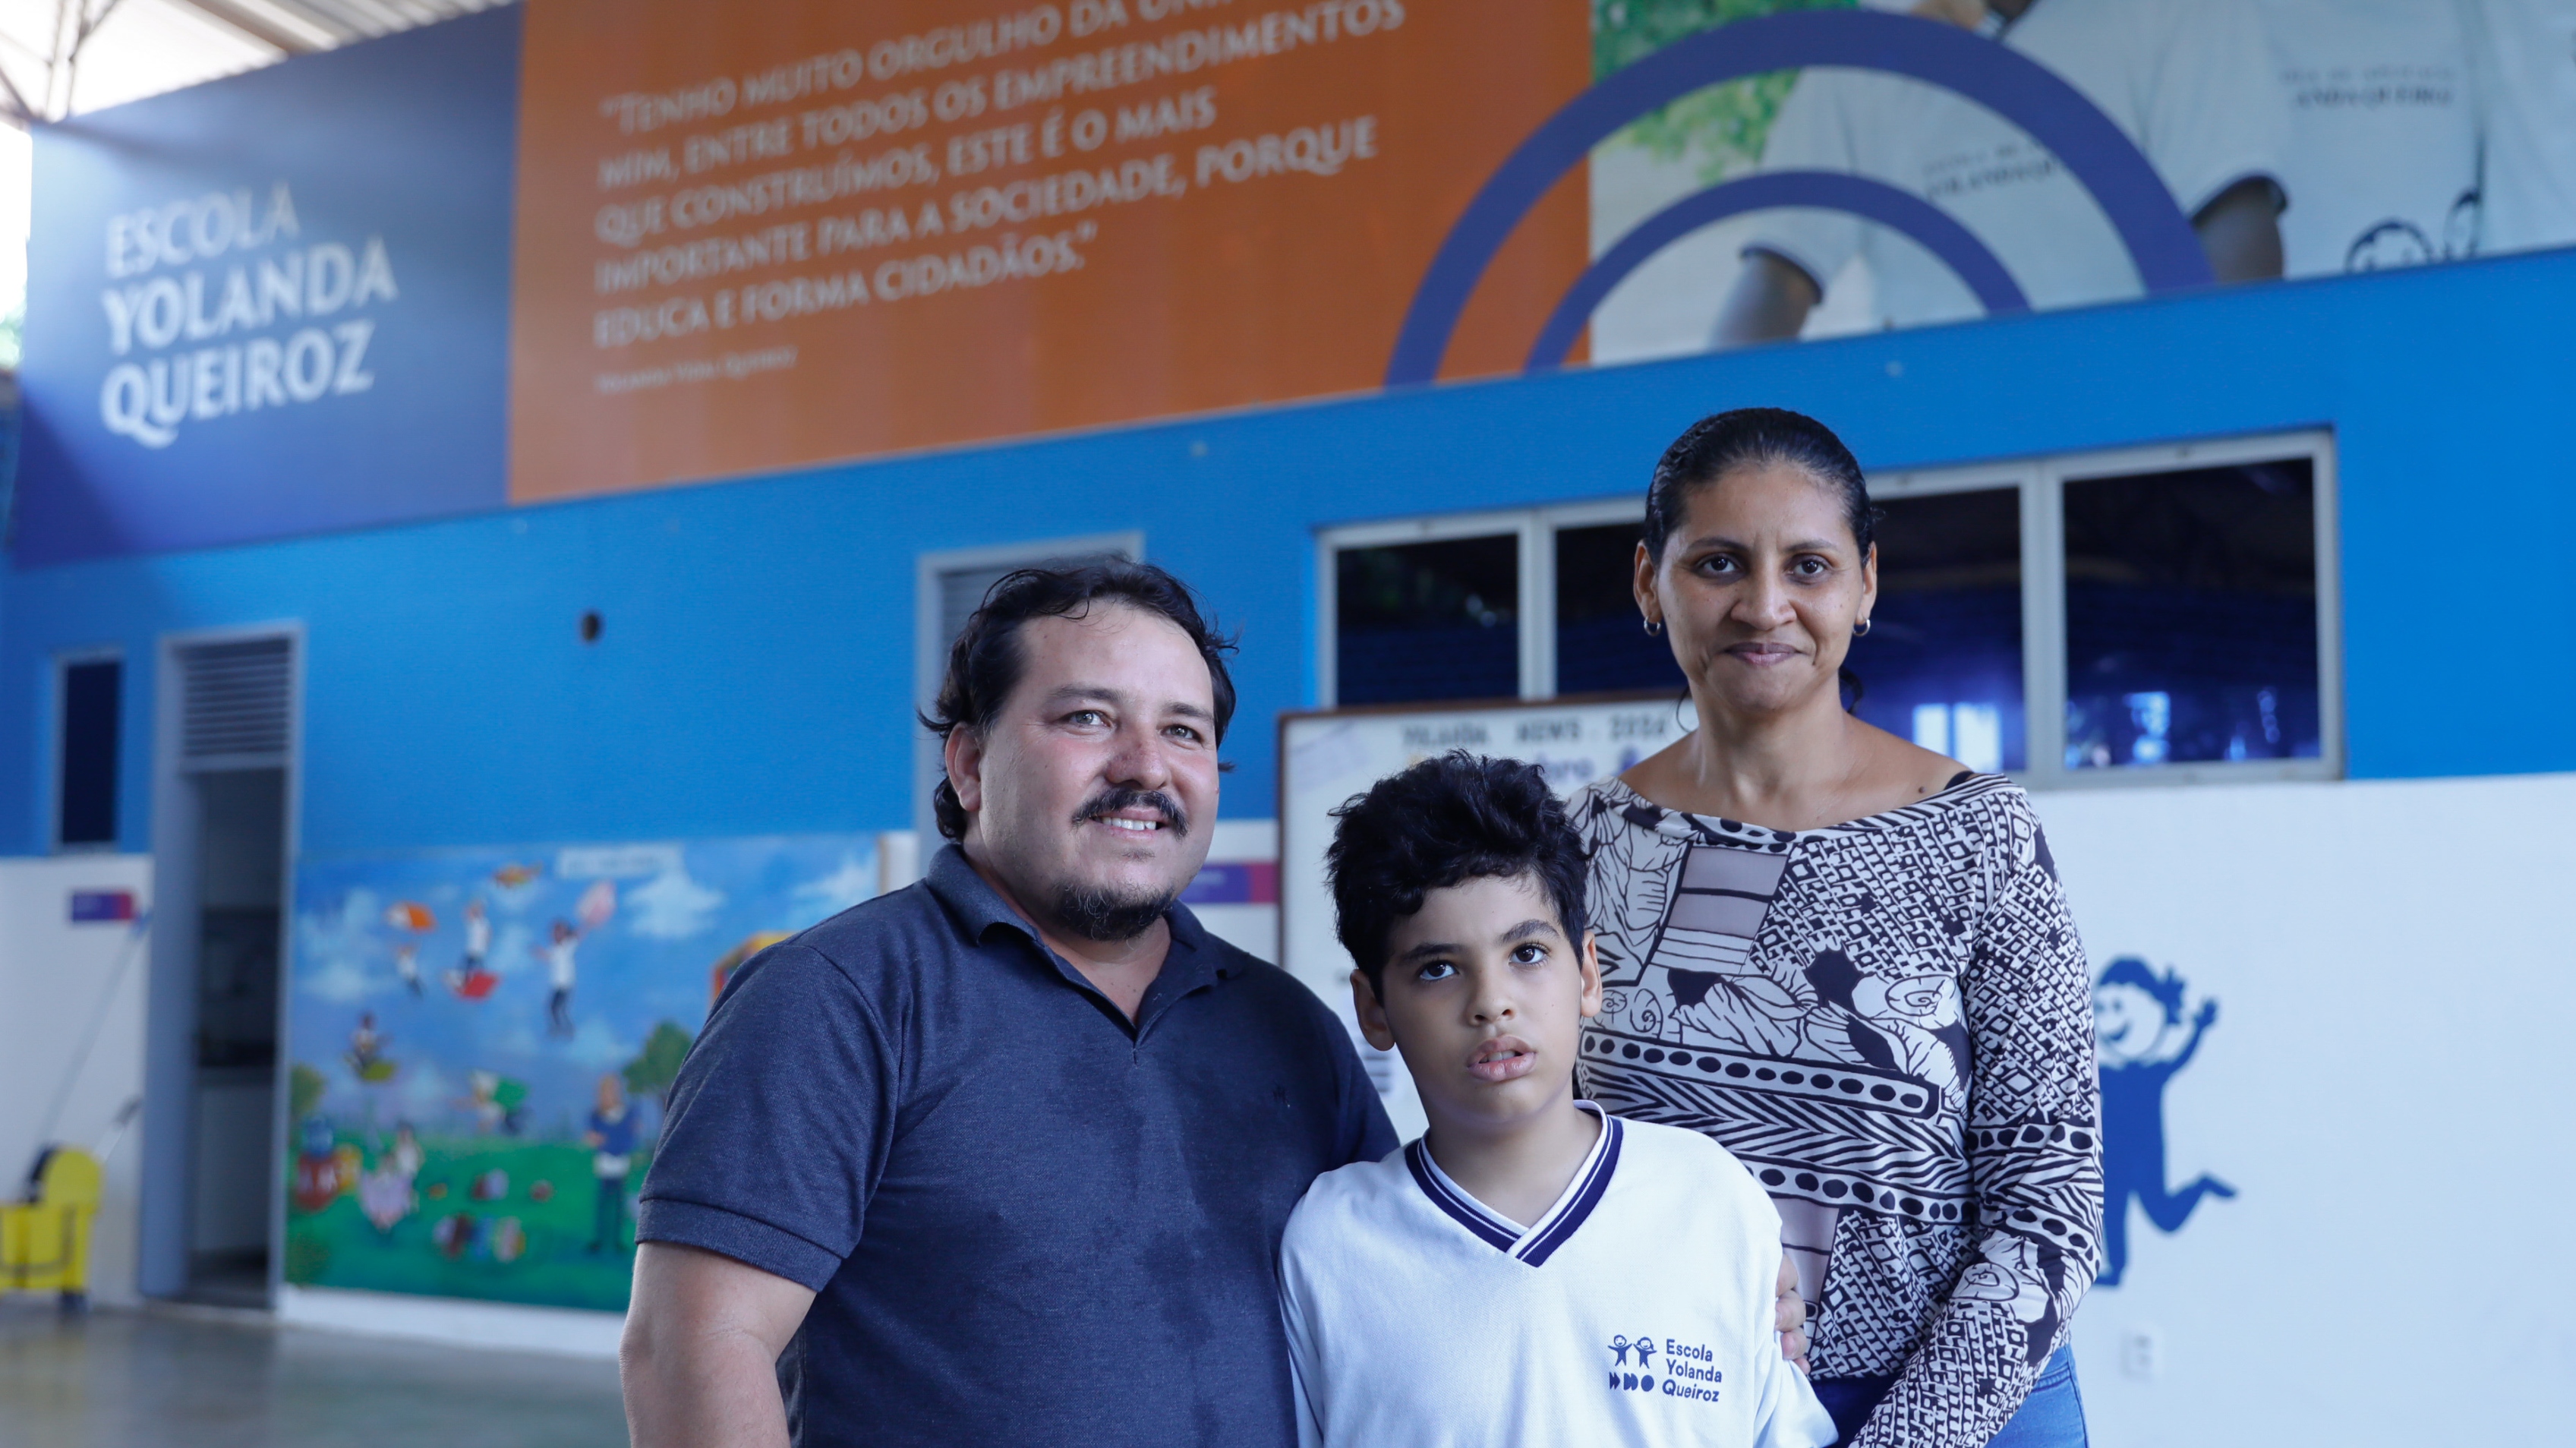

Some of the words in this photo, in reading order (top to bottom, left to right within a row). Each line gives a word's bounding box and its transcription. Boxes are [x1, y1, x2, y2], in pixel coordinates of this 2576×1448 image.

[683, 116, 794, 174] ENTRE
[802, 87, 929, 149] TODOS
[933, 74, 985, 122] OS
[993, 0, 1406, 110] EMPREENDIMENTOS
[742, 49, 863, 107] MUITO
[868, 5, 1061, 81] ORGULHO
[1069, 0, 1128, 37] DA
[594, 196, 667, 248] QUE
[946, 122, 1034, 177] ESTE
[1042, 107, 1066, 159] É
[1071, 109, 1108, 152] O
[1115, 85, 1217, 144] MAIS
[594, 222, 812, 294] IMPORTANTE
[816, 207, 911, 255] PARA
[916, 199, 944, 236] A
[949, 153, 1187, 233] SOCIEDADE,
[1195, 114, 1377, 188] PORQUE
[106, 181, 301, 279] ESCOLA
[102, 234, 399, 355] YOLANDA
[594, 297, 711, 349] EDUCA
[714, 288, 739, 329] E
[741, 269, 871, 323] FORMA
[100, 319, 375, 449] QUEIROZ
[1662, 1378, 1720, 1402] Queiroz
[1666, 1338, 1713, 1362] Escola
[1666, 1358, 1722, 1383] Yolanda
